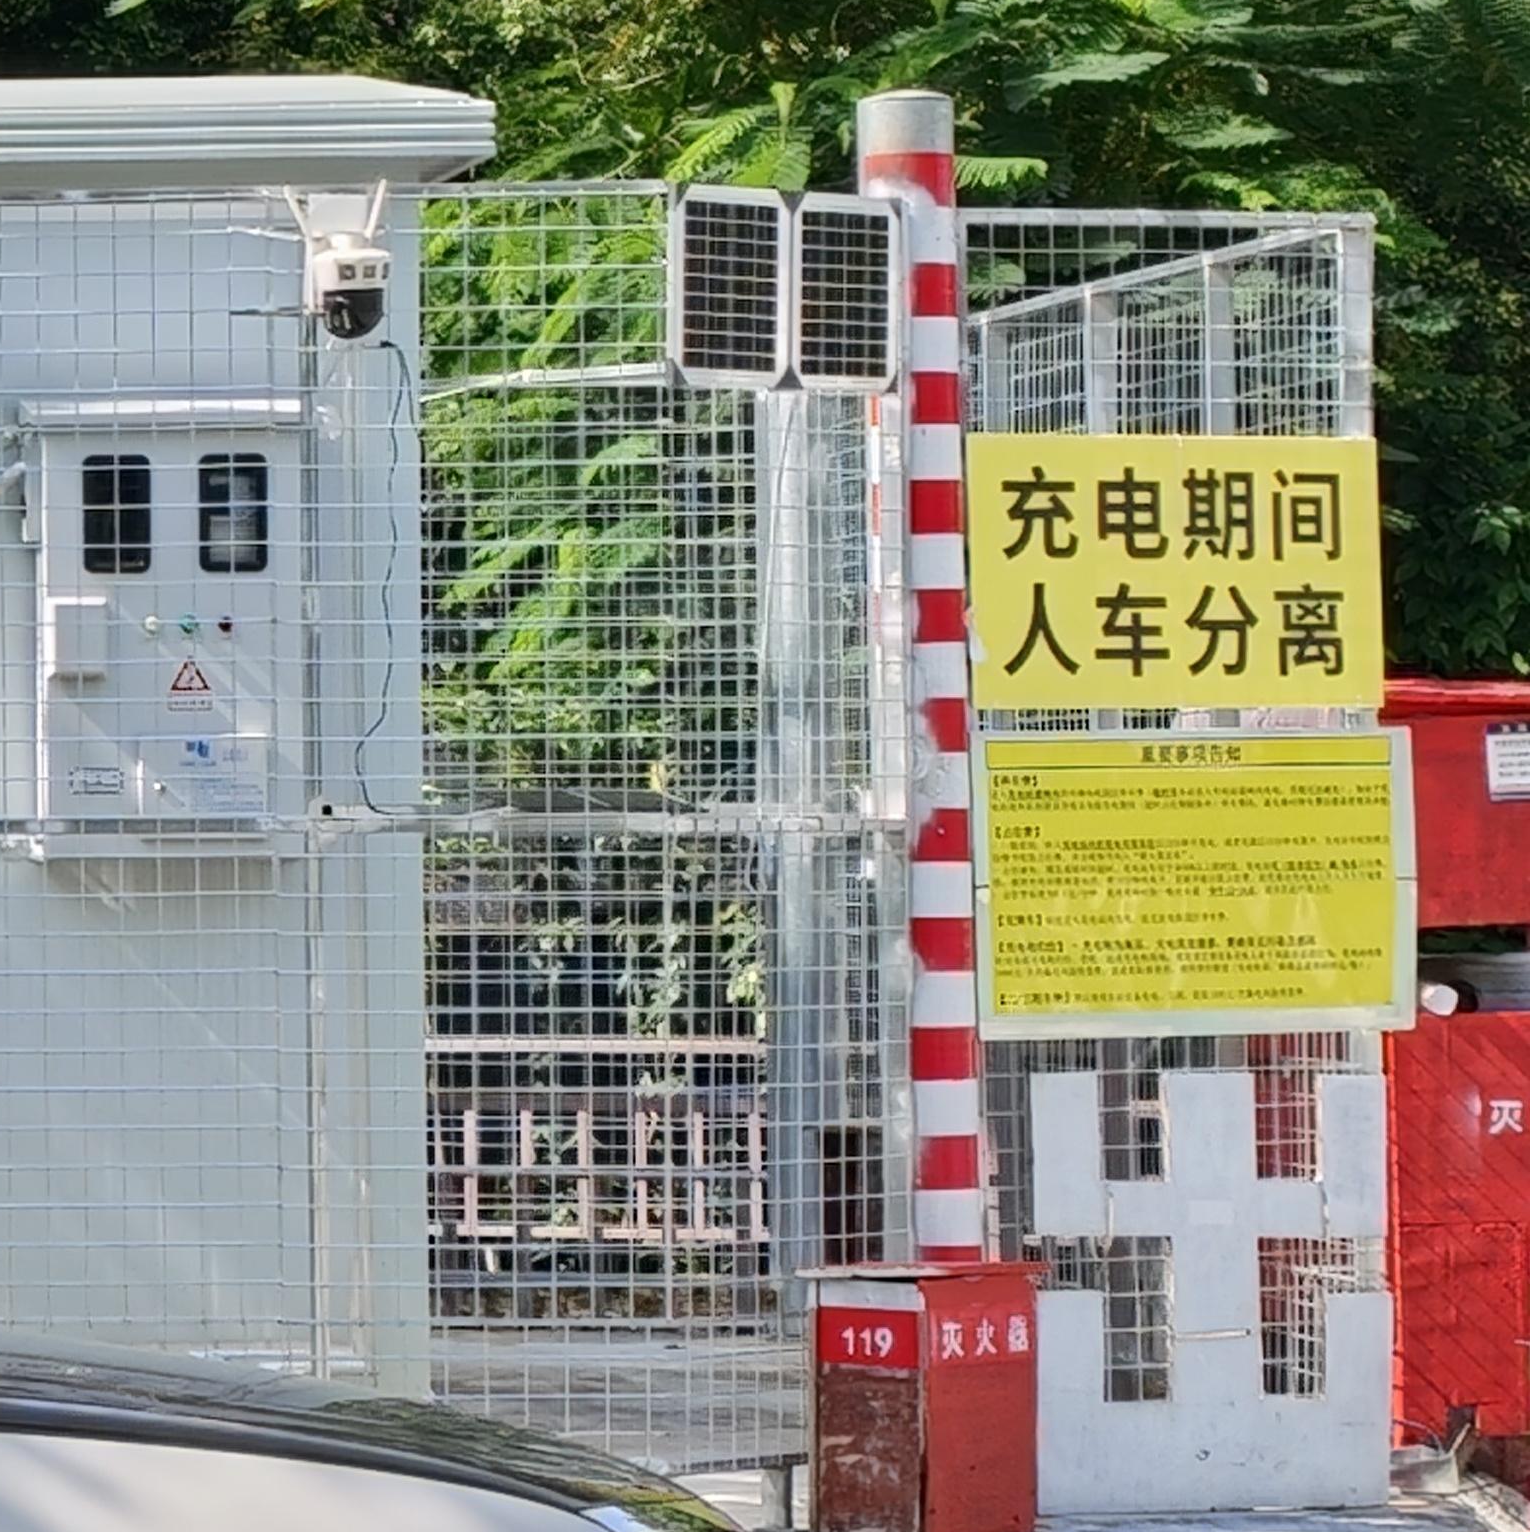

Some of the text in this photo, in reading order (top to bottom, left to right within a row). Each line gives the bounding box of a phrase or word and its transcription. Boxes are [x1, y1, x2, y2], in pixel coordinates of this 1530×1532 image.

[1000, 466, 1343, 562] 充电期间
[1004, 582, 1345, 677] 人车分离
[1488, 1099, 1523, 1135] 灭
[841, 1326, 894, 1358] 119
[941, 1315, 1029, 1360] 灭火器
